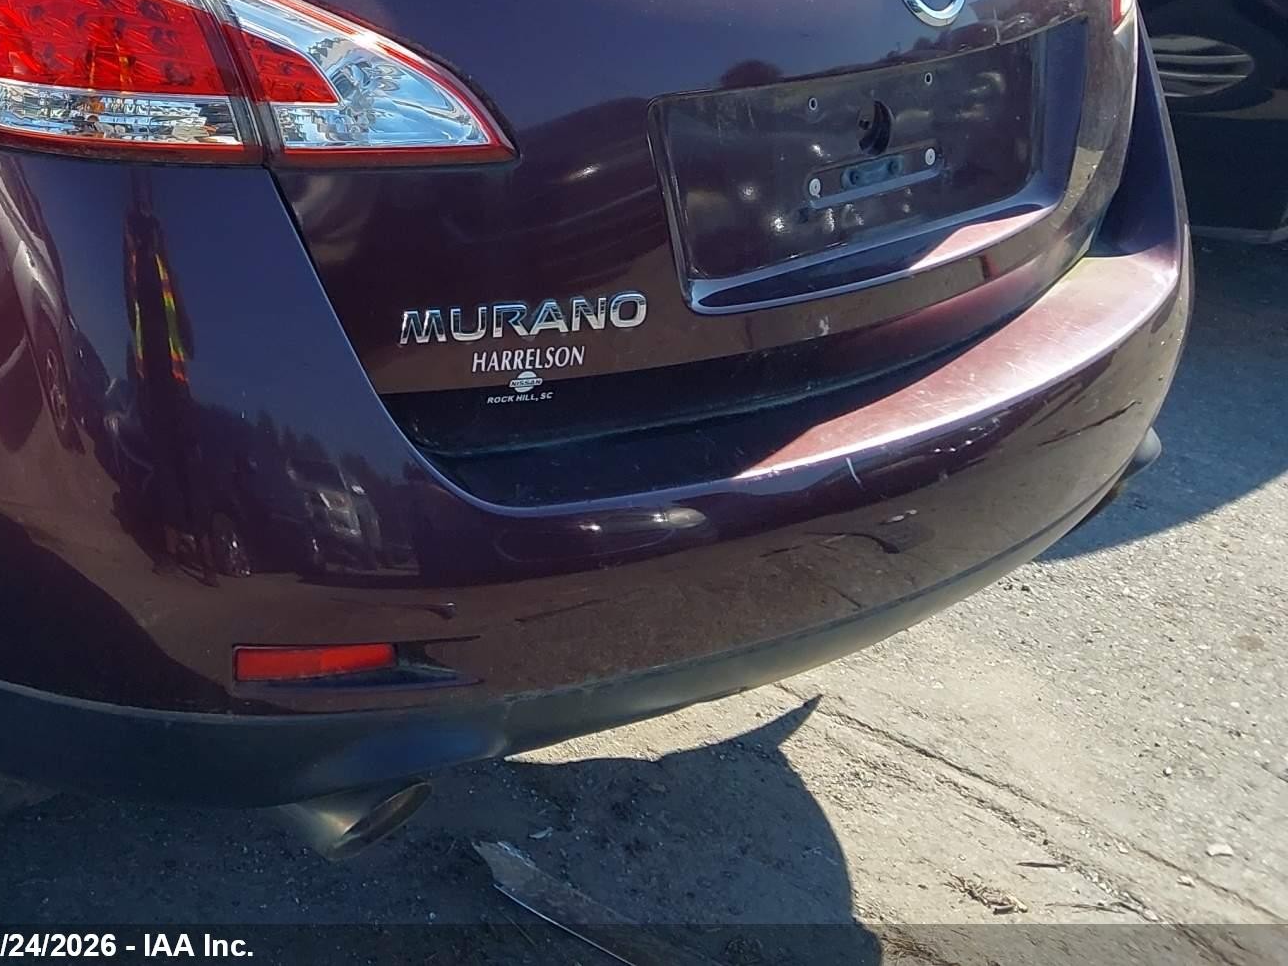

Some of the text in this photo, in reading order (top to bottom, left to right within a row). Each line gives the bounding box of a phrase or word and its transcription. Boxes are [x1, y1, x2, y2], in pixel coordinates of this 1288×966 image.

[399, 290, 648, 346] MURANO
[471, 345, 586, 373] HARRELSON
[487, 395, 515, 404] ROCK
[540, 392, 554, 400] SC
